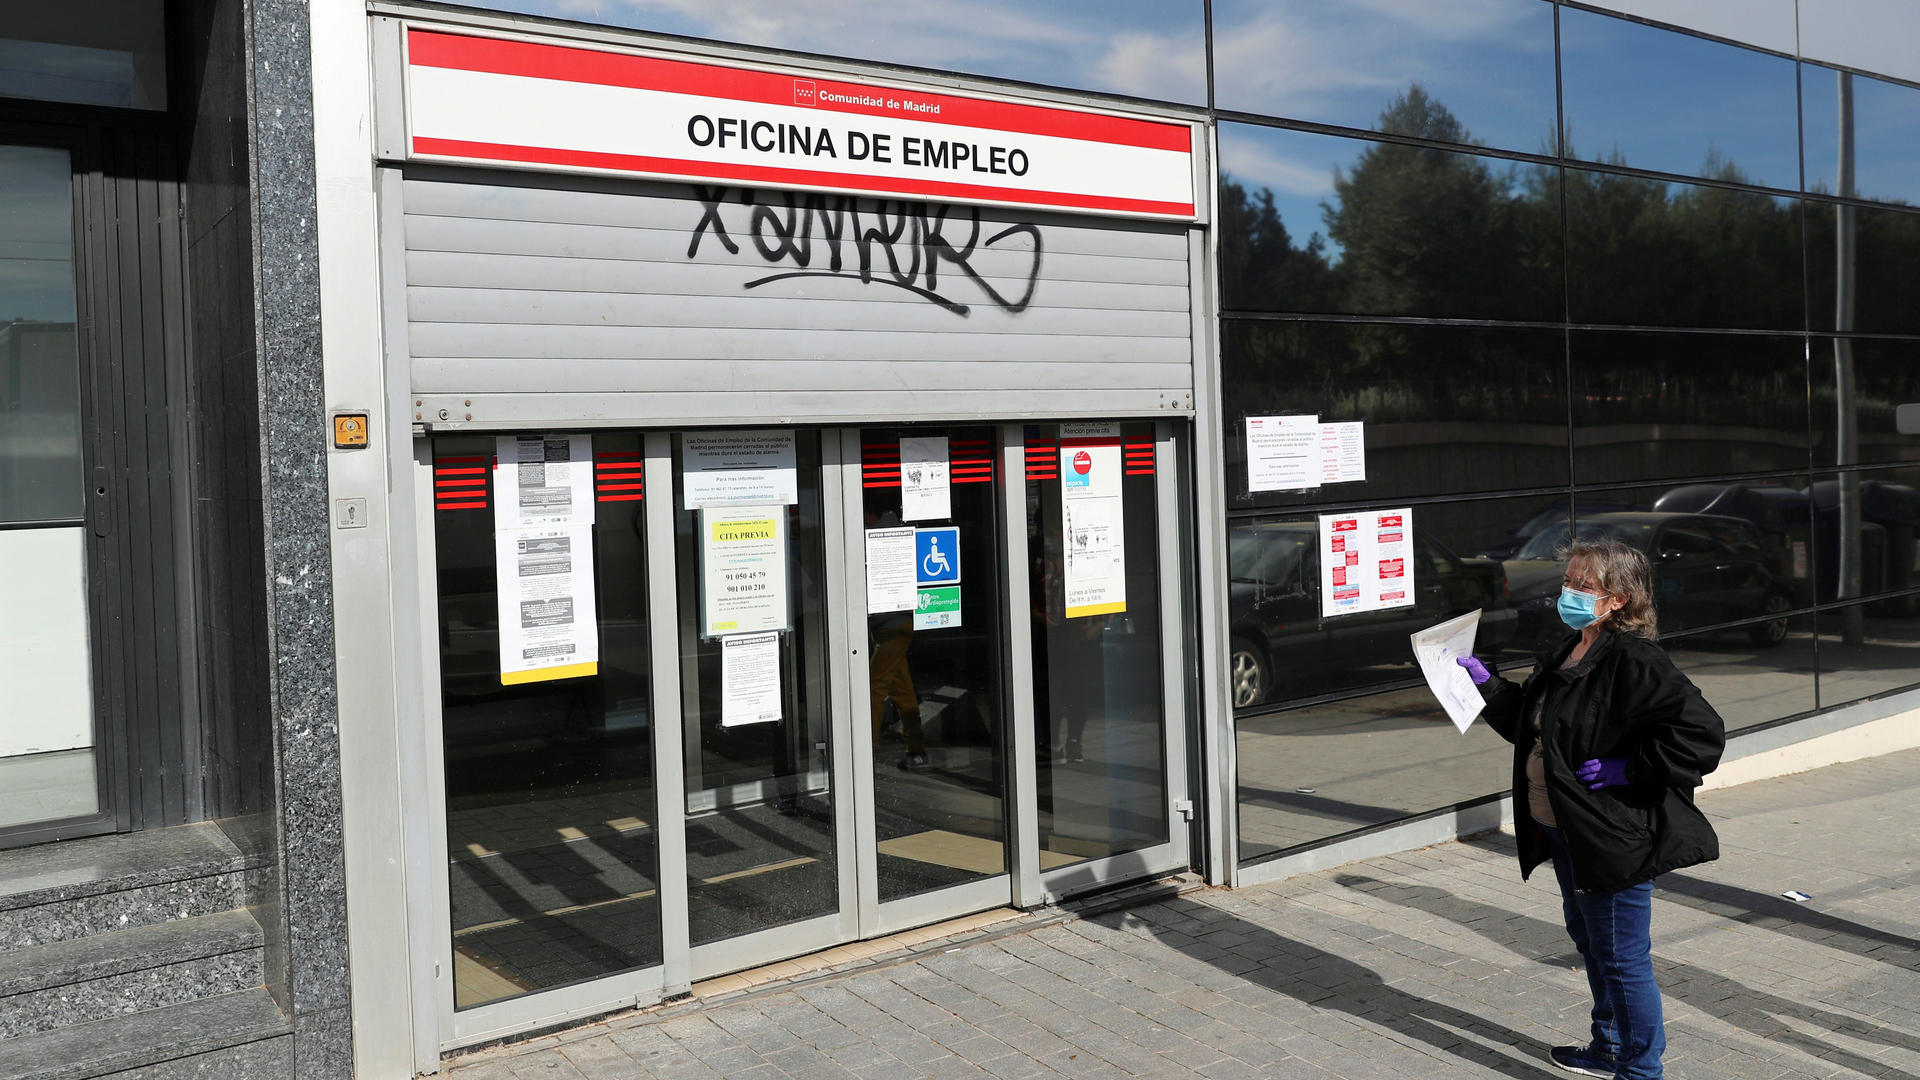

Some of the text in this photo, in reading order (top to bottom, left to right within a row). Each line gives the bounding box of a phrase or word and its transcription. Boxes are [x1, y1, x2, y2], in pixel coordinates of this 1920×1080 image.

[820, 90, 940, 114] Comunidad de Madrid
[688, 114, 1029, 176] OFICINA DE EMPLEO
